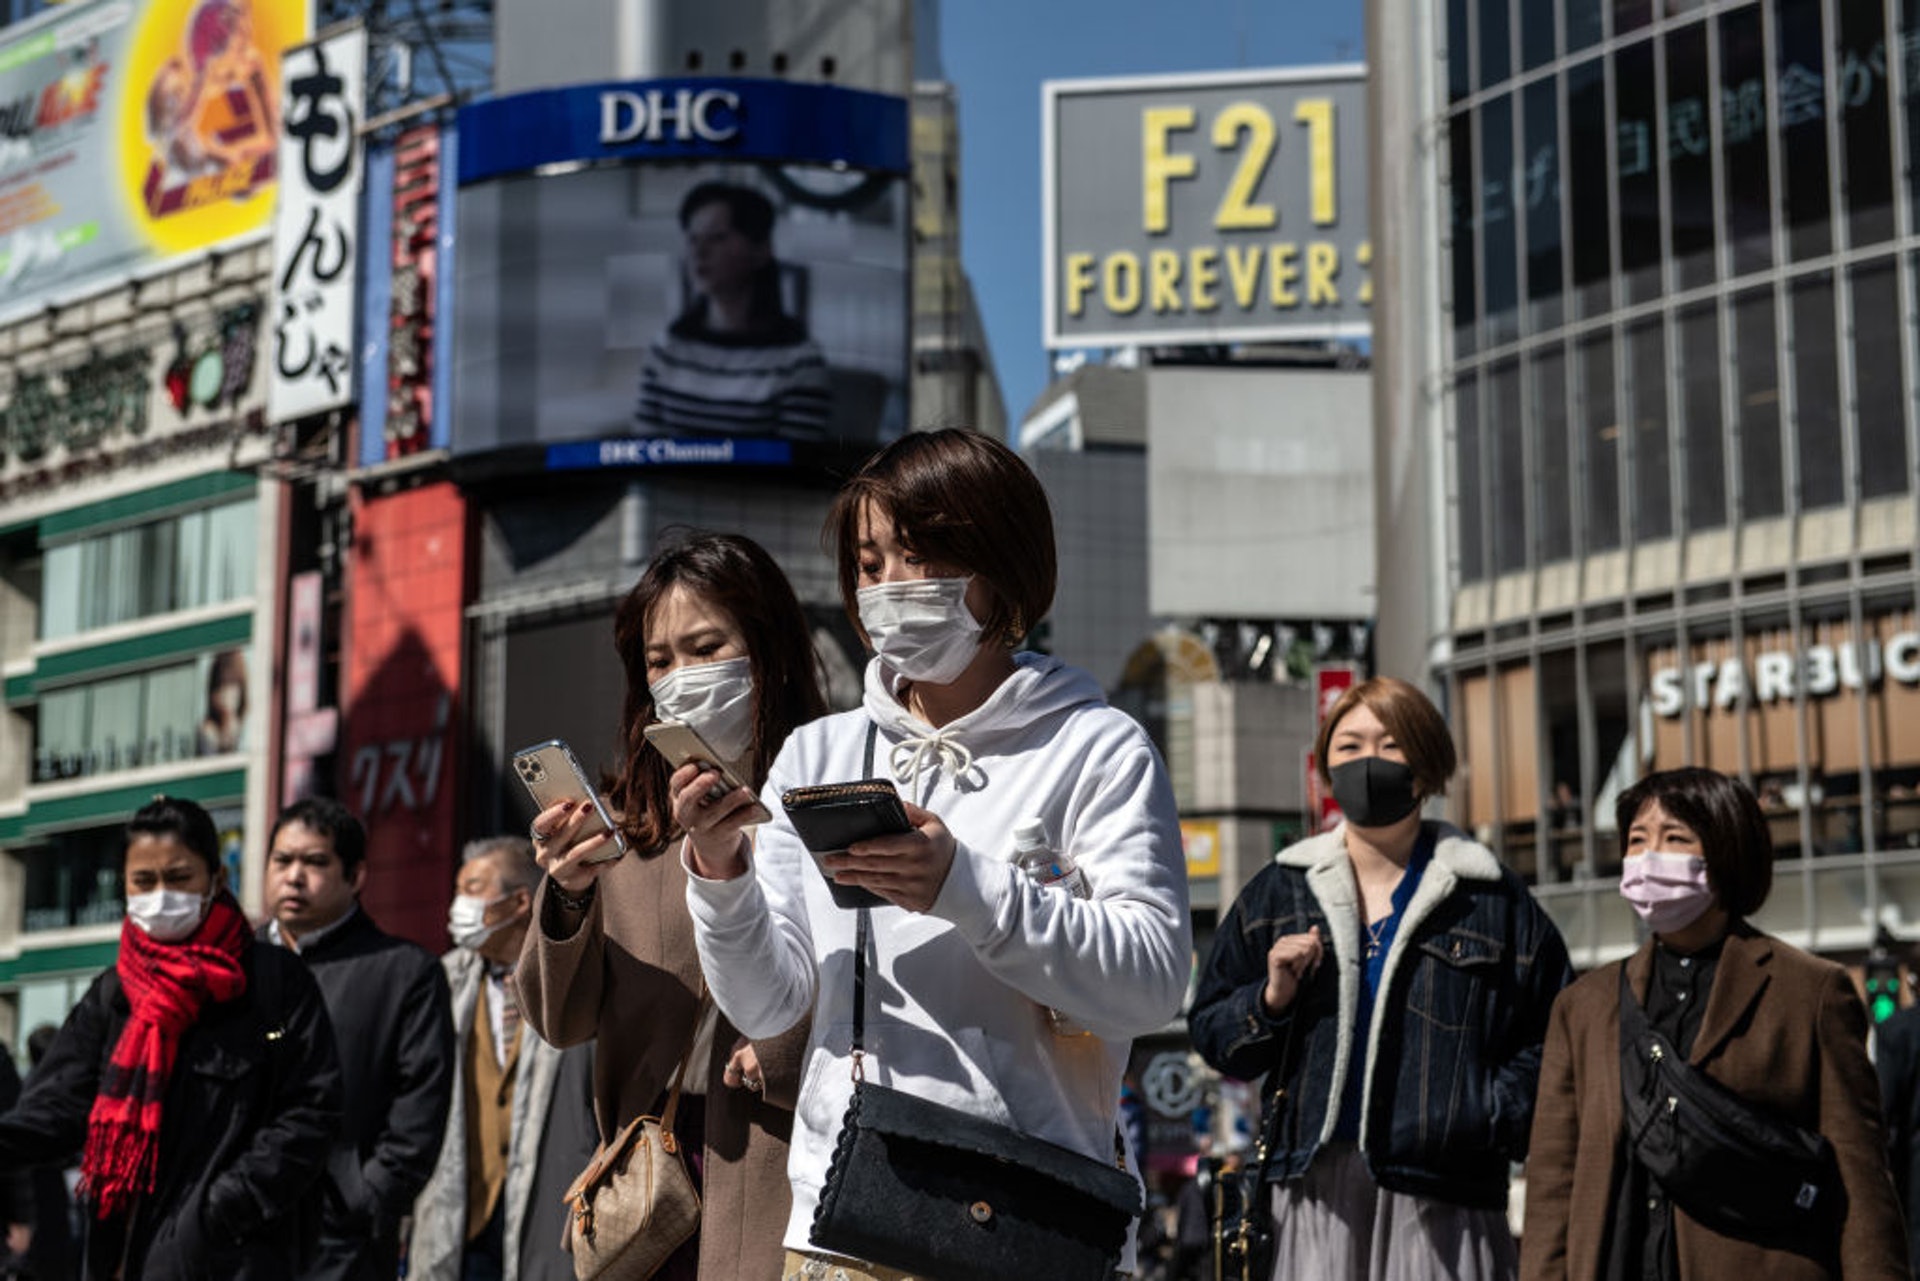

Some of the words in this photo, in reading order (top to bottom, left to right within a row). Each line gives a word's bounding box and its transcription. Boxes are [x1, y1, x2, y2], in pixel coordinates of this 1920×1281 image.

[600, 90, 740, 145] DHC
[1141, 97, 1336, 233] F21
[276, 44, 354, 396] もんじゃ
[1064, 241, 1339, 317] FOREVER
